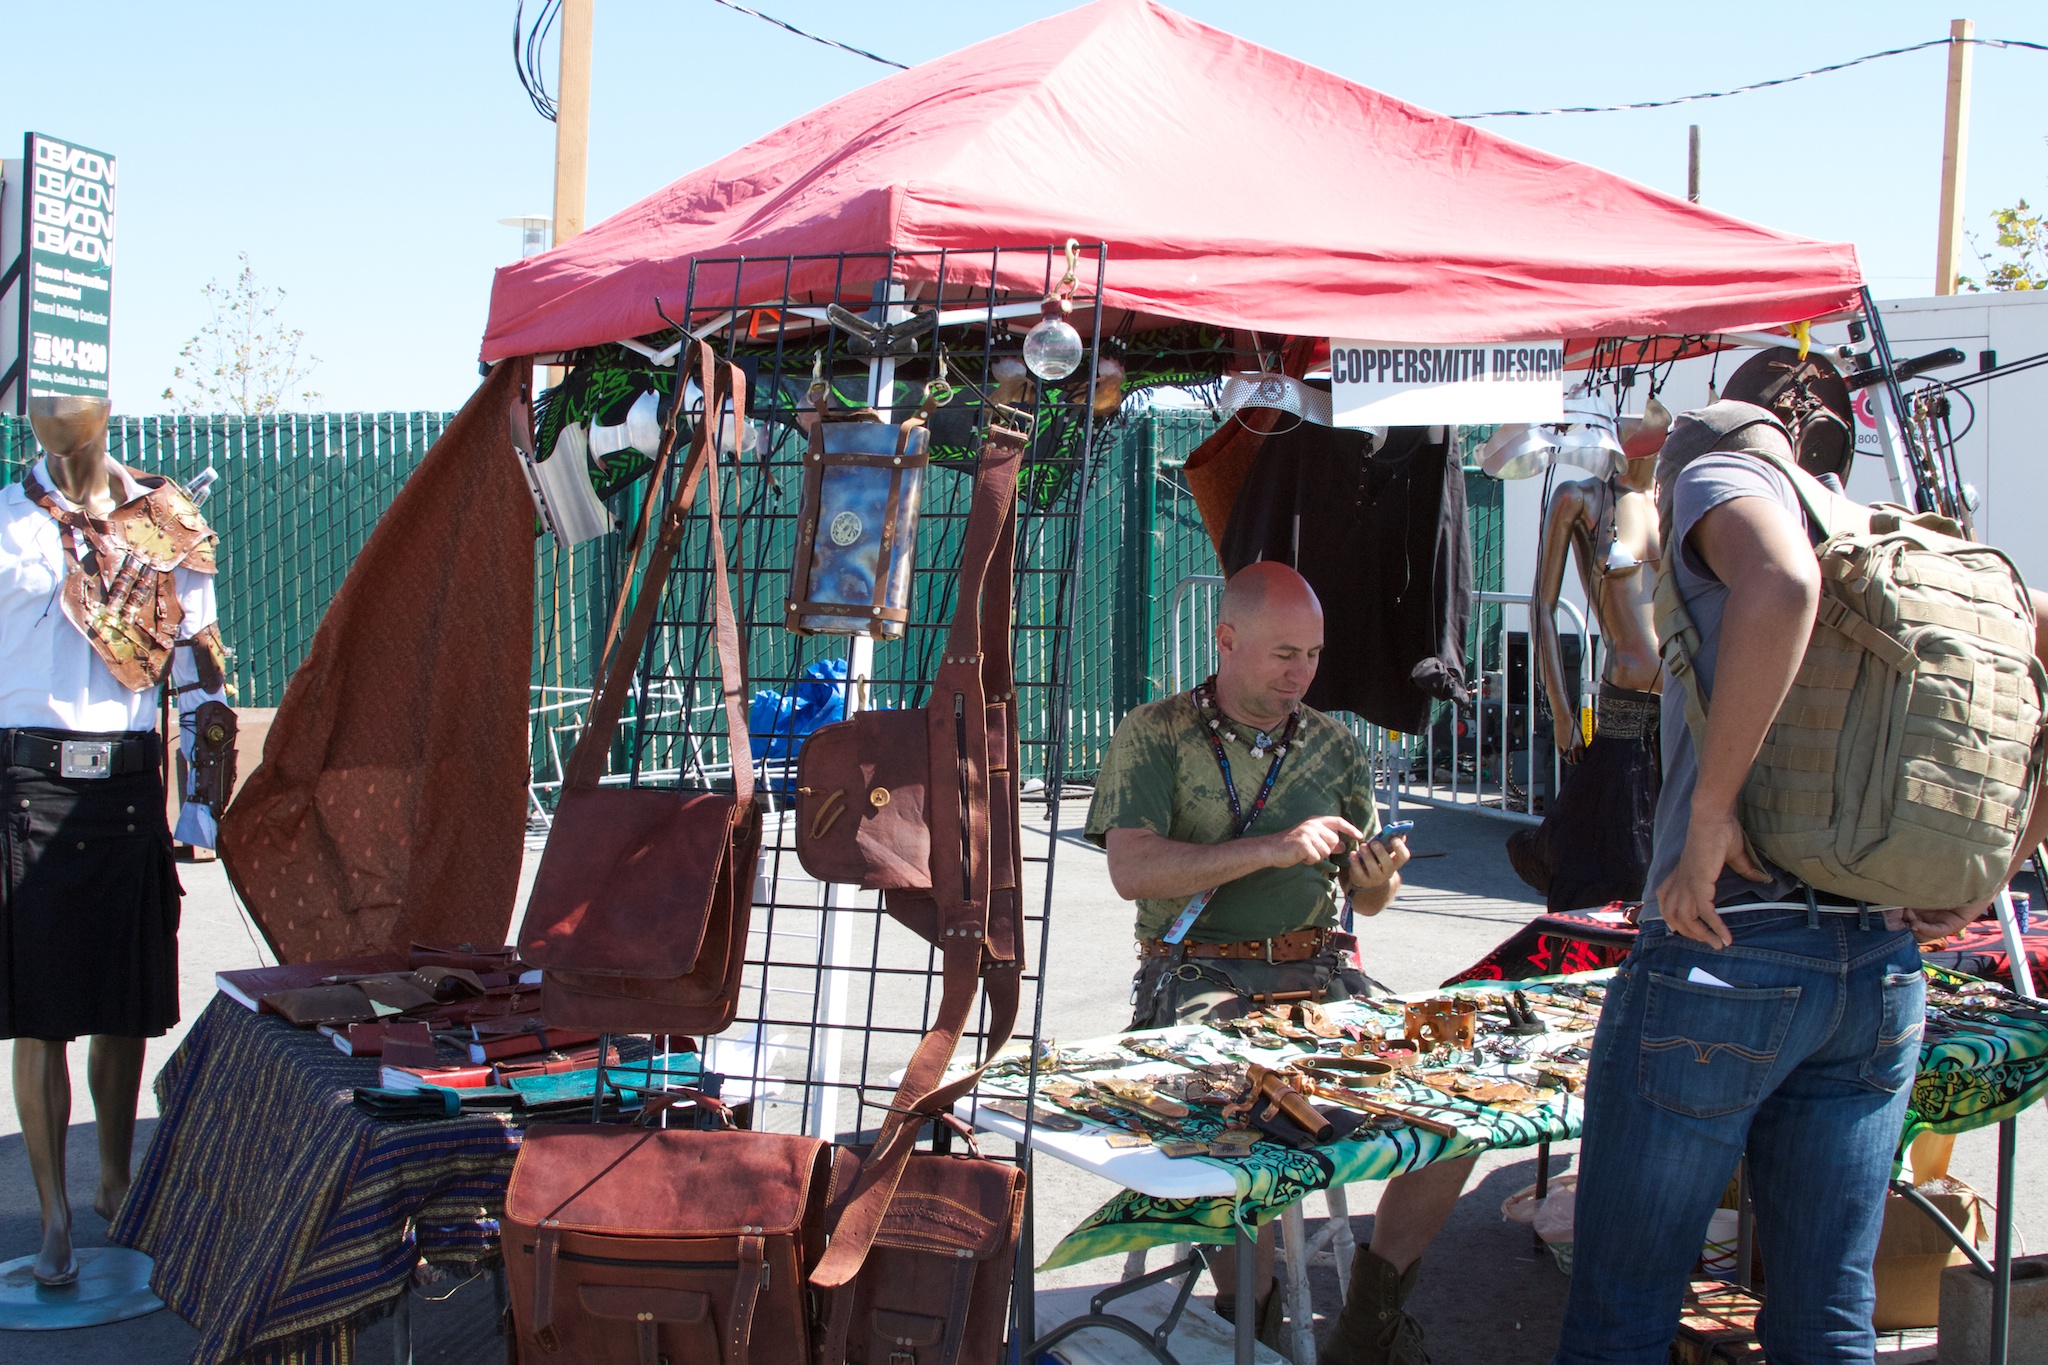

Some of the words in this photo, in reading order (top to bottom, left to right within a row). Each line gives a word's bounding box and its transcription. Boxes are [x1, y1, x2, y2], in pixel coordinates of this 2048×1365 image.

[35, 137, 115, 186] DEVCON
[34, 167, 114, 213] DEVCON
[33, 194, 113, 240] DEVCON
[32, 222, 112, 267] DEVCON
[33, 299, 56, 315] General
[56, 303, 79, 323] Building
[79, 308, 108, 326] Contractor
[53, 372, 79, 387] California
[1332, 348, 1485, 384] COPPERSMITH
[1492, 348, 1562, 382] DESIGN
